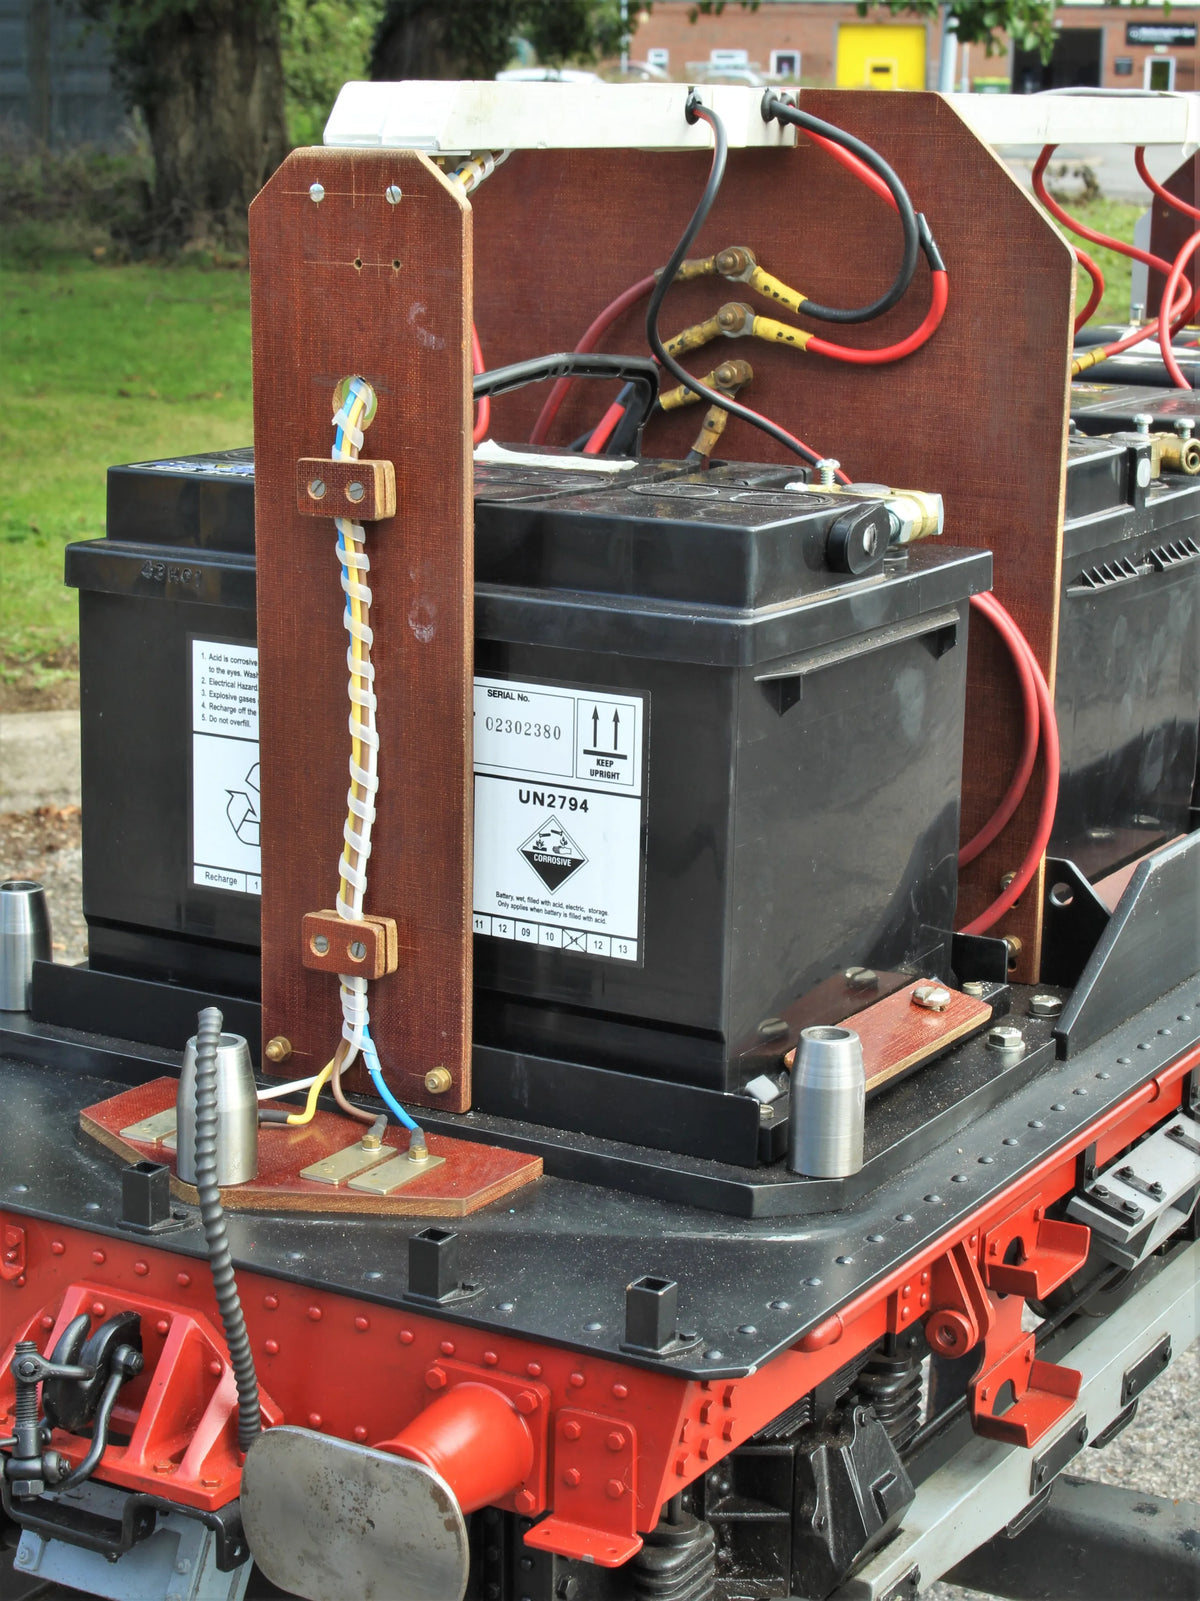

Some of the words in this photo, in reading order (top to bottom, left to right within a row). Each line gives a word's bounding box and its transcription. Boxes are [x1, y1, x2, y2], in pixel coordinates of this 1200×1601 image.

[209, 653, 222, 662] Acid
[230, 657, 257, 666] corrosive
[209, 678, 235, 688] Electrical
[237, 682, 258, 691] Hazard
[209, 690, 237, 701] Explosive
[487, 689, 515, 700] SERIAL
[517, 694, 530, 702] No.
[209, 703, 237, 714] Recharge
[248, 708, 256, 716] the
[230, 719, 251, 727] overfill.
[485, 716, 561, 740] 02302380
[596, 758, 614, 768] KEEP
[589, 769, 620, 780] UPRIGHT
[518, 789, 589, 813] UN2794
[534, 853, 572, 867] CORROSIVE
[205, 872, 238, 886] Recharge
[496, 891, 514, 902] Battery,
[527, 896, 540, 905] filled
[540, 898, 551, 906] with
[552, 900, 564, 909] acid,
[588, 907, 608, 917] storage.
[498, 901, 509, 909] Only
[510, 902, 529, 913] applies
[529, 906, 543, 914] when
[544, 908, 562, 919] battery
[568, 912, 581, 921] filled
[582, 914, 593, 923] with
[594, 916, 607, 924] acid.
[475, 920, 483, 929] 11
[498, 924, 507, 933] 12
[521, 928, 531, 937] 09
[545, 932, 554, 941] 10
[594, 941, 603, 949] 12
[619, 945, 628, 953] 13
